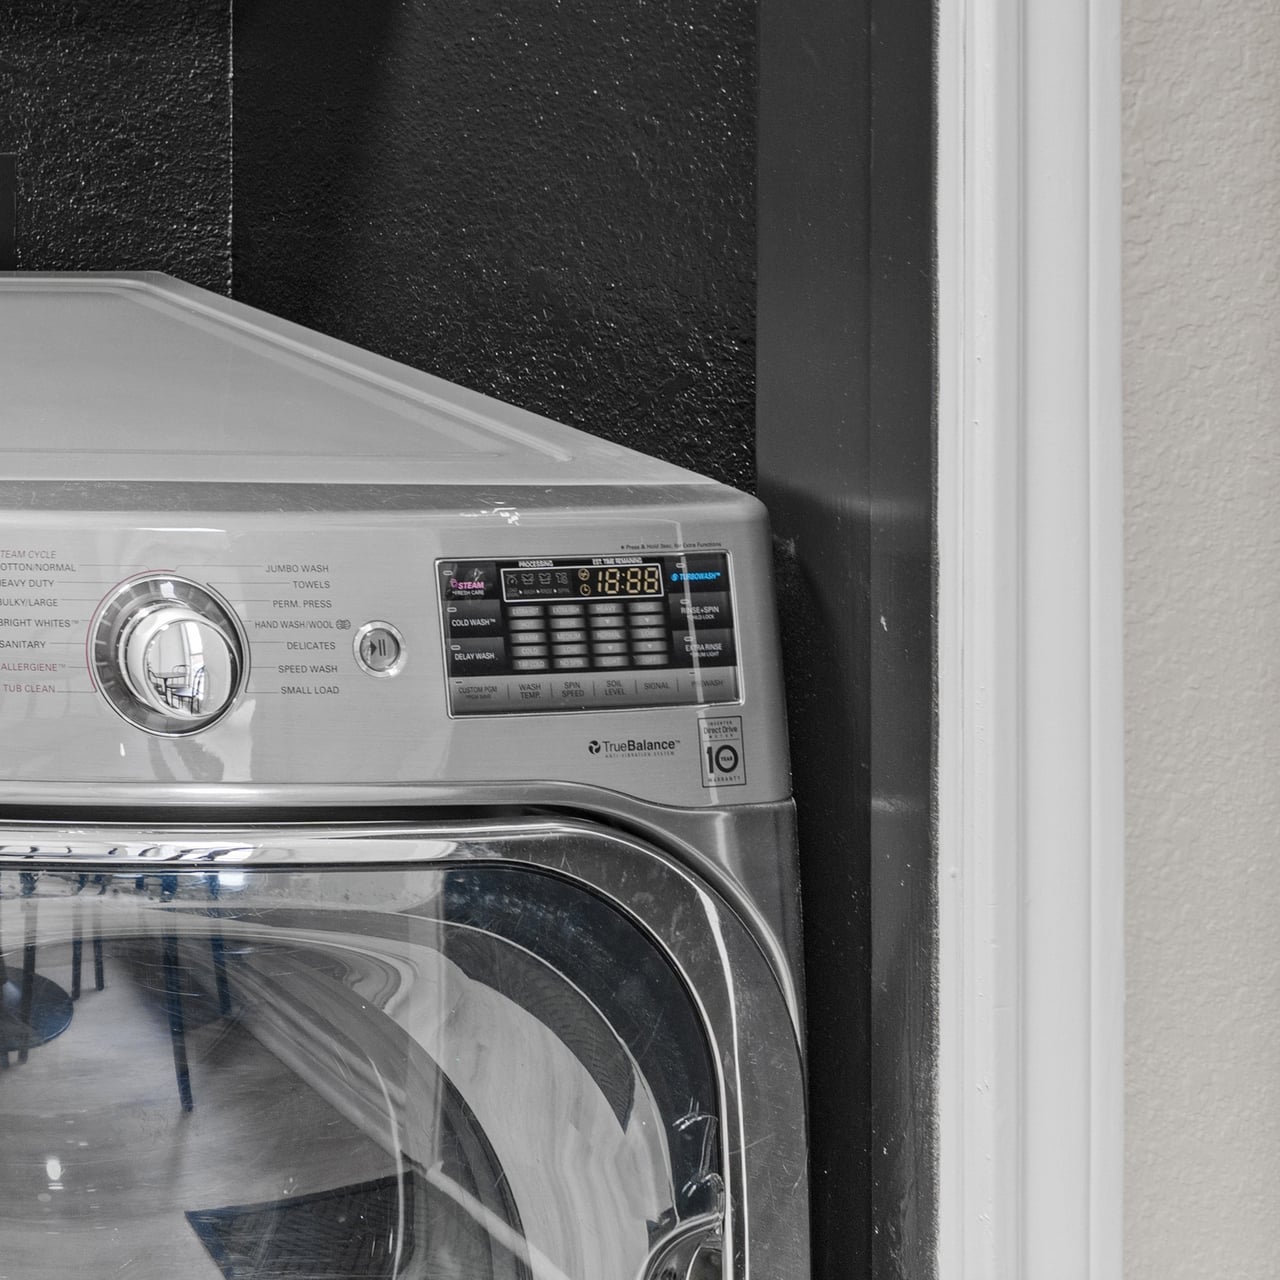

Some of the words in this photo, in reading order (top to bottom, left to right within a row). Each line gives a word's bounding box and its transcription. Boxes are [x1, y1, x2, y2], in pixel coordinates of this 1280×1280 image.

[28, 551, 57, 559] CYCLE
[265, 565, 299, 573] JUMBO
[301, 565, 329, 573] WASH
[28, 579, 55, 588] DUTY
[293, 581, 330, 589] TOWELS
[458, 581, 484, 590] STEAM
[303, 600, 332, 608] PRESS
[255, 620, 278, 629] HAND
[452, 619, 469, 627] COLD
[0, 640, 46, 649] SANITARY
[287, 642, 336, 650] DELICATES
[475, 652, 495, 660] WASH
[278, 665, 308, 674] SPEED
[310, 665, 338, 673] WASH
[564, 681, 581, 689] SPIN
[606, 680, 622, 688] SOIL
[644, 682, 669, 690] SIGNAL
[3, 684, 22, 693] TUB
[25, 685, 55, 693] CLEAN
[281, 686, 312, 694] SMALL
[314, 686, 340, 694] LOAD
[604, 688, 625, 696] LEVEL
[703, 727, 721, 735] Direct
[707, 745, 738, 773] 10
